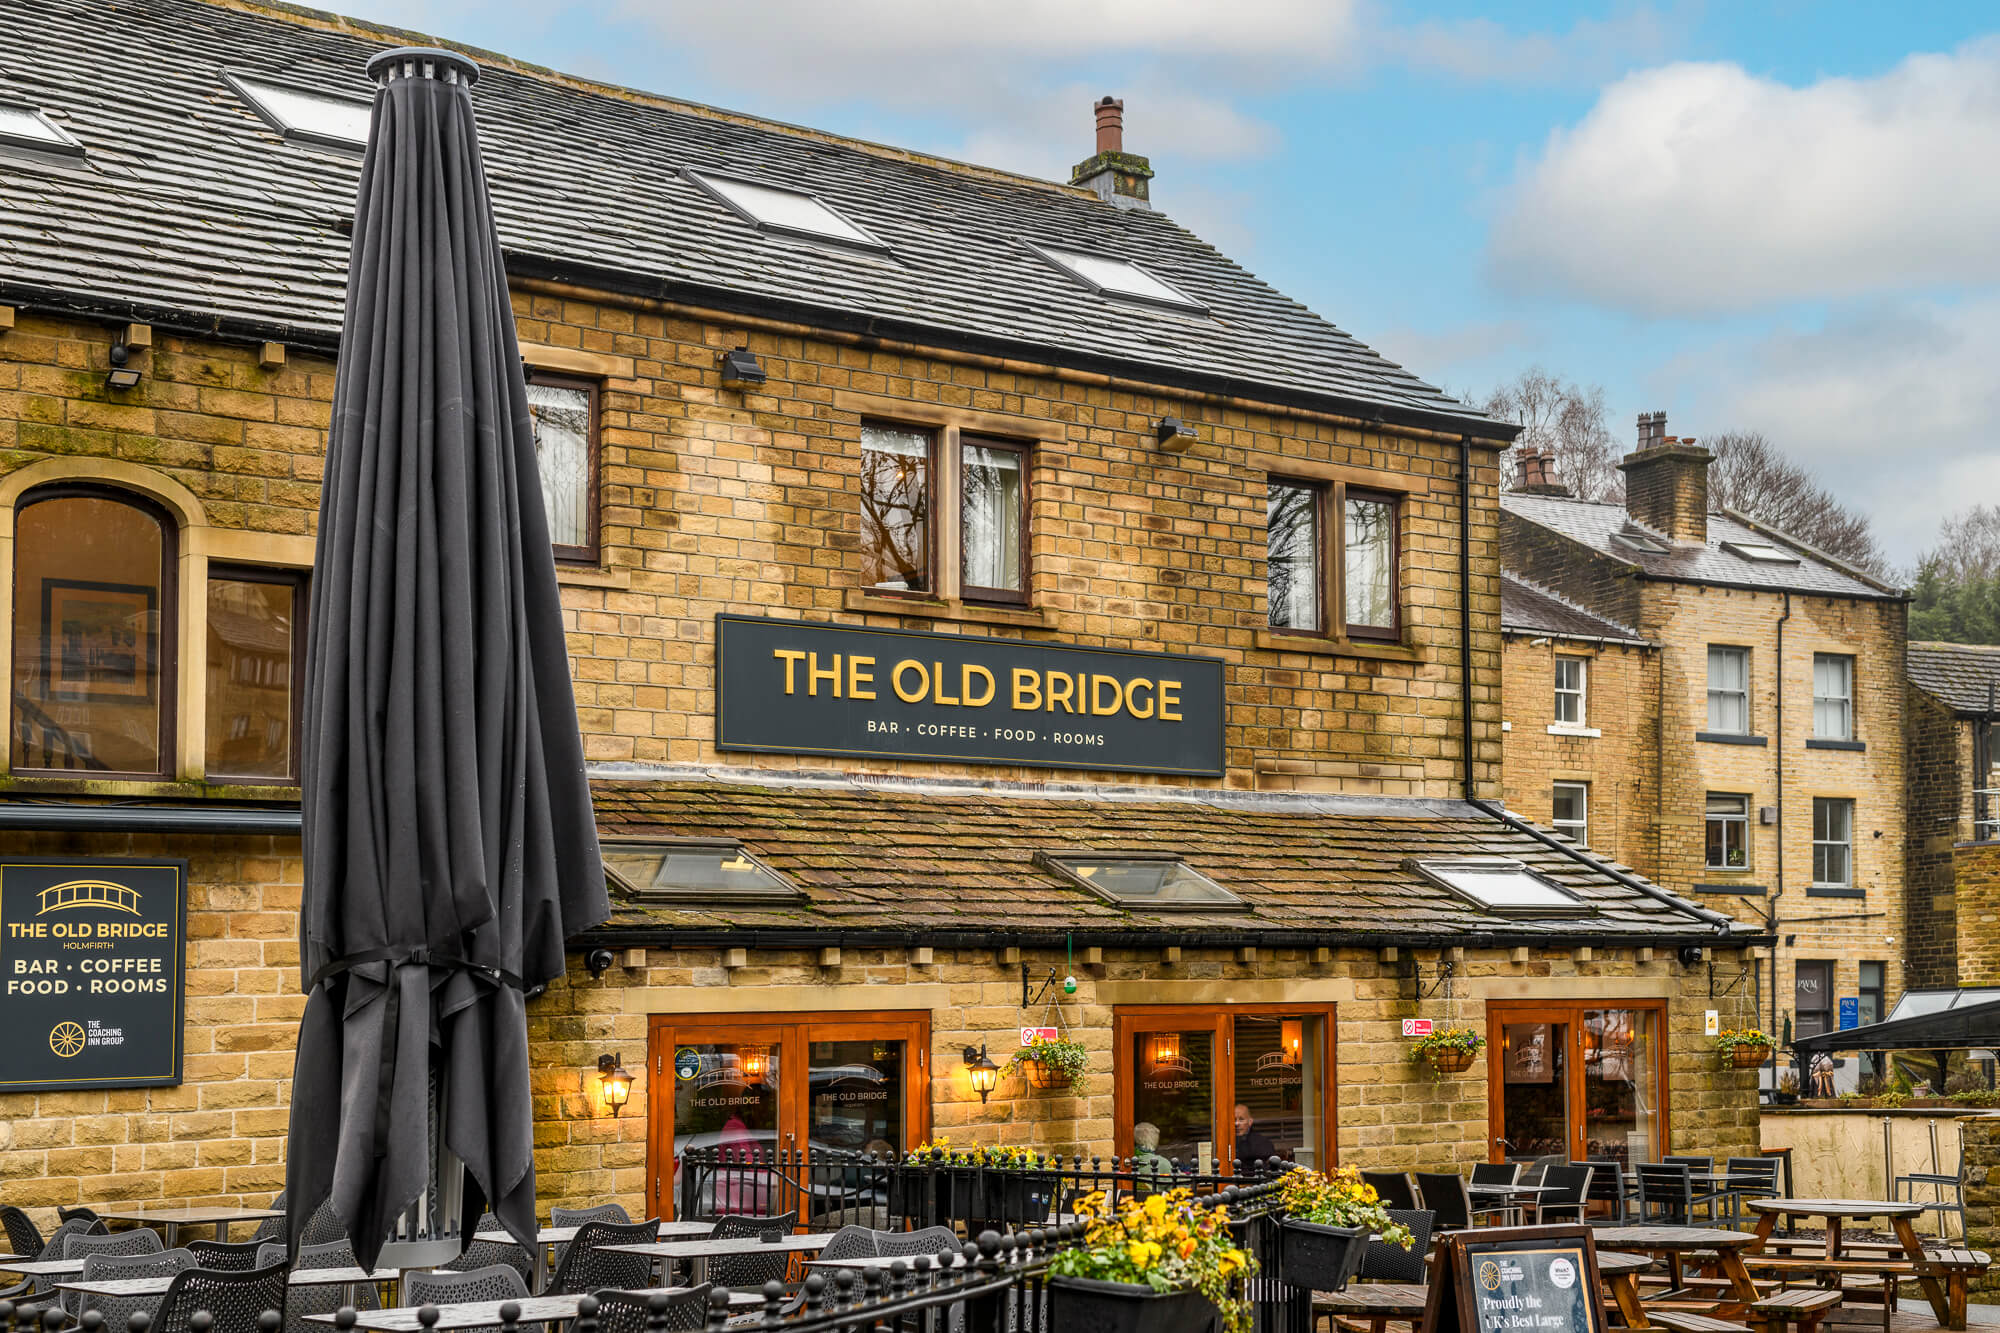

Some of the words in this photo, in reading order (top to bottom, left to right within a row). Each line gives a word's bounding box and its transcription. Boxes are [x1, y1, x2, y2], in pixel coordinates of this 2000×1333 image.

[774, 649, 877, 700] THE
[891, 659, 996, 707] OLD
[1011, 667, 1183, 722] BRIDGE
[867, 720, 899, 734] BAR
[917, 723, 977, 739] COFFEE
[994, 728, 1036, 742] FOOD
[1053, 732, 1105, 747] ROOMS
[8, 923, 47, 938] THE
[52, 923, 92, 938] OLD
[97, 923, 168, 937] BRIDGE
[63, 941, 114, 950] HOLMFIRTH
[14, 959, 59, 974] BAR
[80, 958, 162, 974] COFFEE
[7, 980, 69, 995] FOOD
[90, 978, 167, 994] ROOMS
[88, 1020, 101, 1029] THE
[88, 1028, 122, 1037] COACHING
[88, 1037, 100, 1046] INN
[101, 1036, 124, 1046] GROUP
[1144, 1081, 1158, 1089] THE
[1158, 1081, 1173, 1089] OLD
[1174, 1080, 1199, 1088] BRIDGE
[1250, 1078, 1263, 1086] THE
[1264, 1078, 1277, 1086] OLD
[1279, 1077, 1303, 1085] BRIDGE
[690, 1098, 707, 1107] THE
[708, 1097, 727, 1106] OLD
[728, 1096, 760, 1105] BRIDGE
[822, 1093, 838, 1101] THE
[839, 1092, 856, 1101] OLD
[858, 1091, 888, 1100] BRIDGE
[1483, 1295, 1523, 1311] Proudly
[1525, 1294, 1542, 1308] the
[1485, 1315, 1510, 1329] UK's
[1511, 1314, 1533, 1327] Best
[1535, 1313, 1564, 1329] Large
